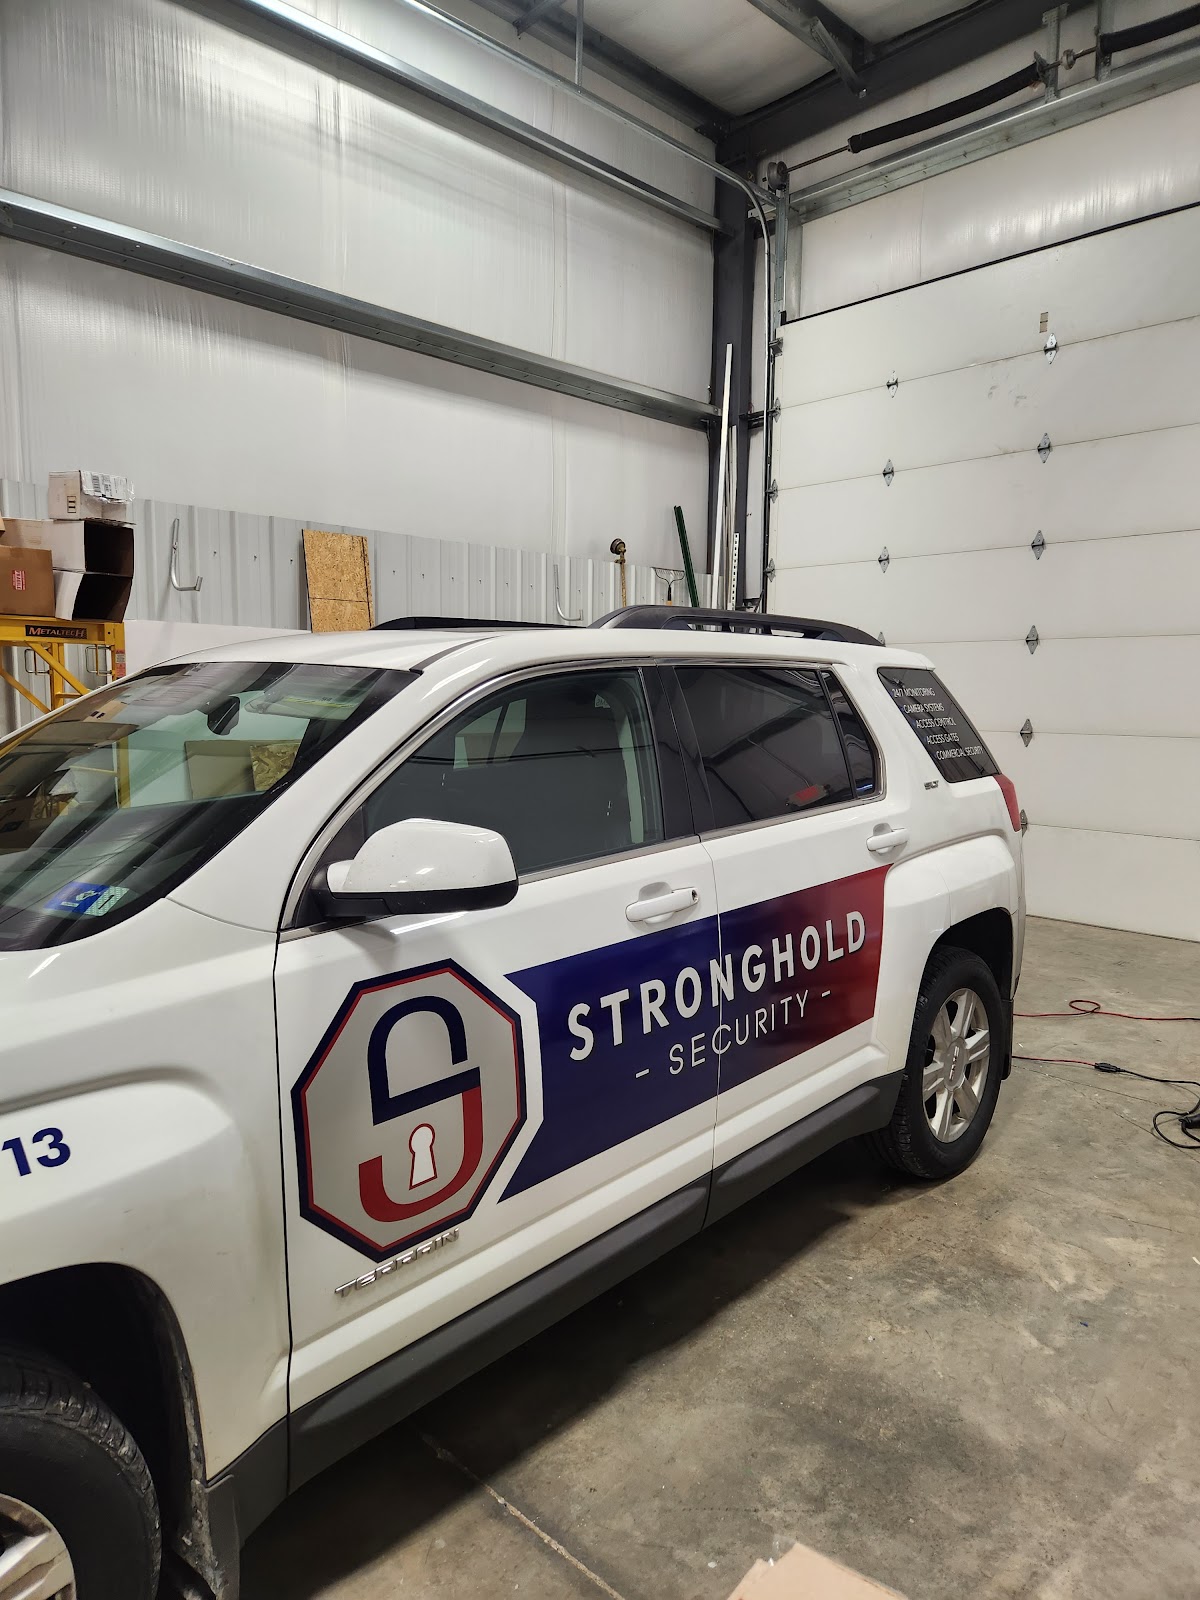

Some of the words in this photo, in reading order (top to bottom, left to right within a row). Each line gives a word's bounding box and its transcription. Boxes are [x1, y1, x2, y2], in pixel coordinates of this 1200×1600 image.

[28, 627, 84, 638] METALTECH
[903, 687, 936, 697] MONITORING
[903, 704, 925, 714] CAMERA
[924, 703, 945, 712] SYSTEMS
[916, 719, 935, 728] ACCESS
[934, 717, 957, 728] CONTROL
[926, 734, 945, 745] ACCESS
[944, 732, 960, 743] GATES
[936, 748, 966, 760] COMMERCIAL
[964, 745, 984, 756] SECURITY
[567, 910, 866, 1061] STRONGHOLD
[669, 989, 808, 1075] SECURITY
[2, 1127, 71, 1177] 13
[334, 1227, 459, 1298] TERRAIN
